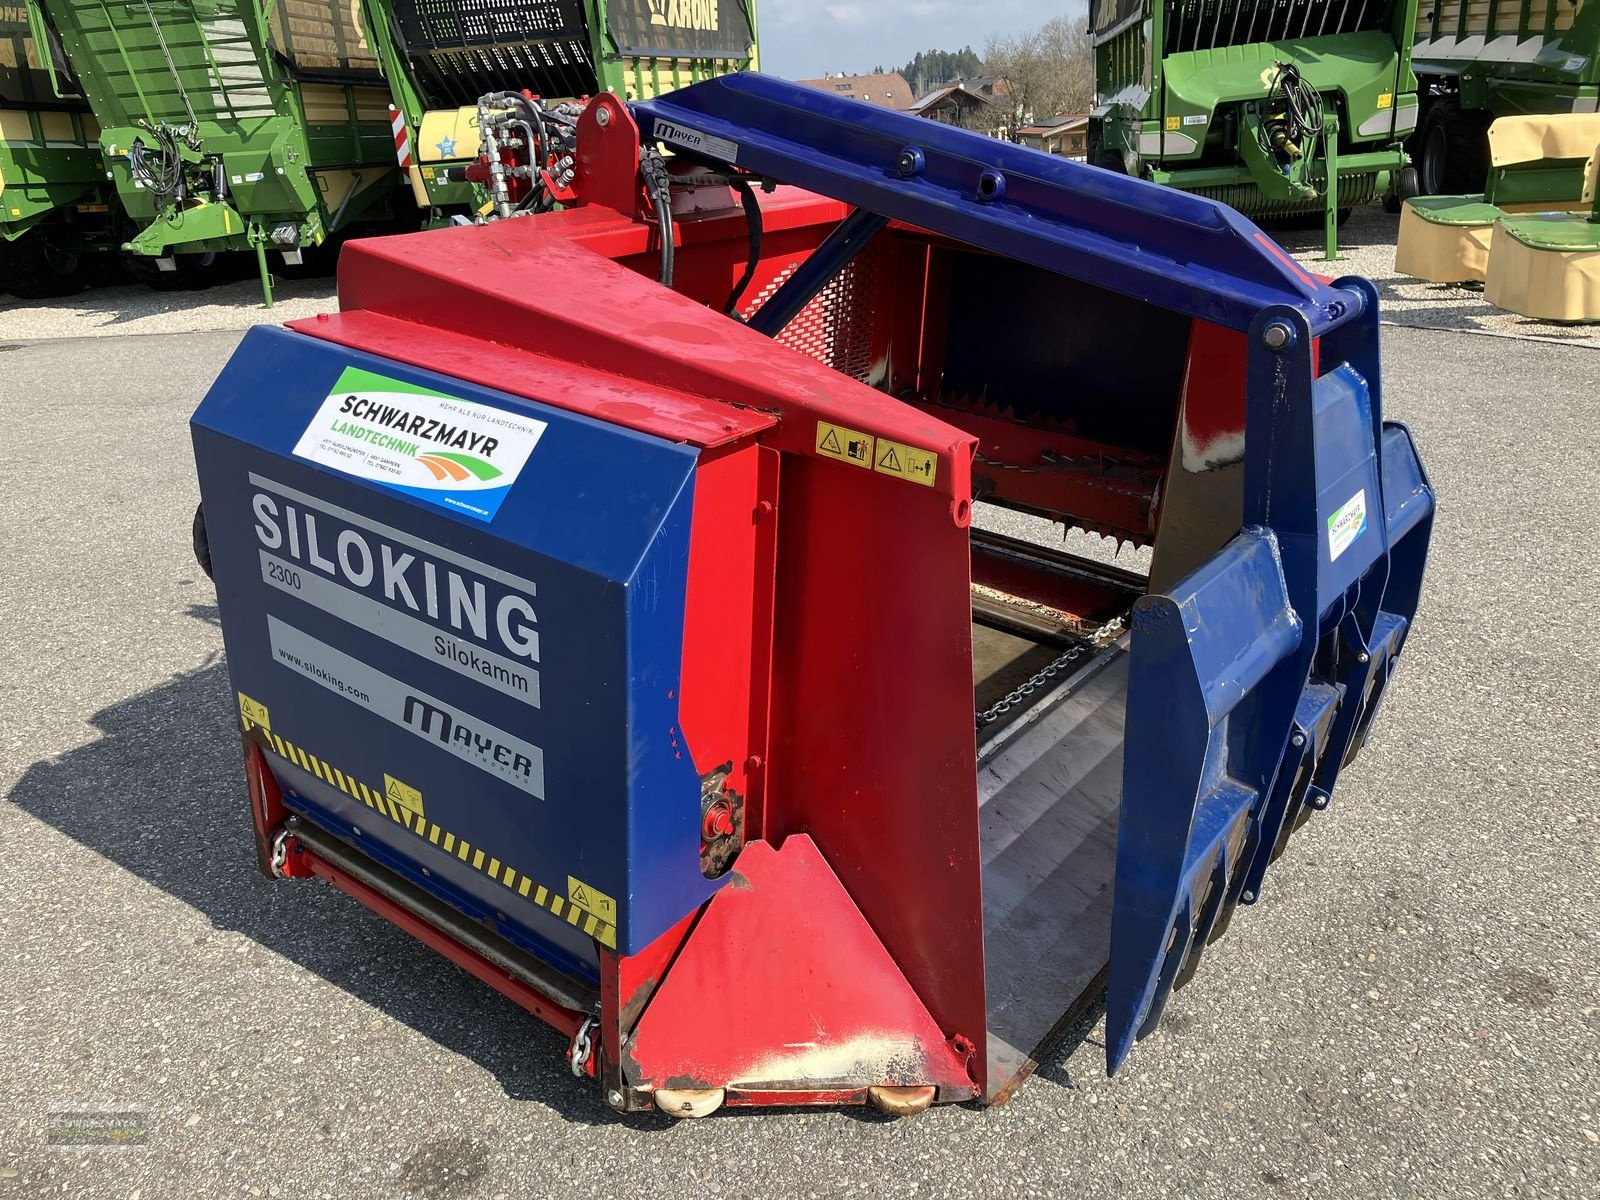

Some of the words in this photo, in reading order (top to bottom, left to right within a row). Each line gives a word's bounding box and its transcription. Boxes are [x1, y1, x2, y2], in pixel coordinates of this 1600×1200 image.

[656, 123, 701, 145] MAYER
[330, 418, 421, 458] LANDTECHNIK
[339, 394, 500, 459] SCHWARZMAYR
[439, 402, 457, 412] MEHR
[458, 408, 470, 416] ALS
[472, 412, 486, 420] NUR
[252, 493, 541, 664] SILOKING
[268, 561, 301, 590] 2300
[278, 647, 370, 703] www.siloking.com
[434, 636, 529, 693] Silokamm
[403, 695, 533, 777] MAYER
